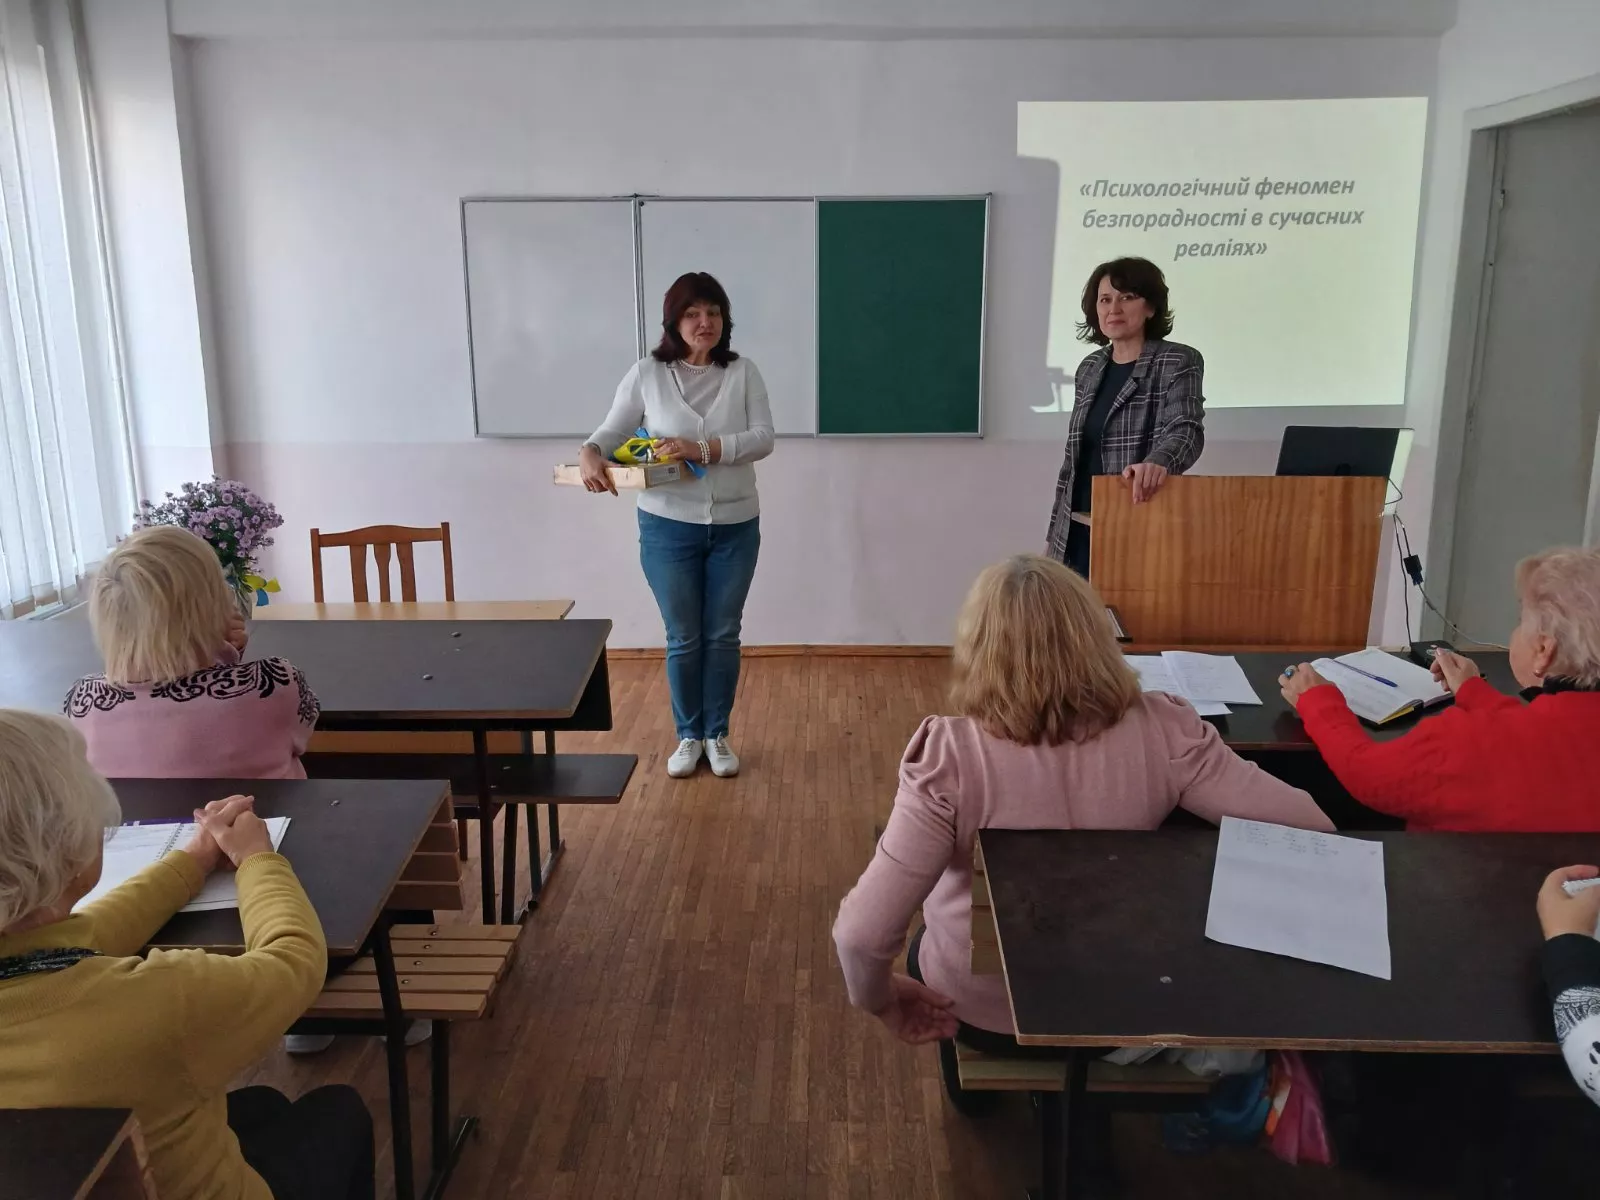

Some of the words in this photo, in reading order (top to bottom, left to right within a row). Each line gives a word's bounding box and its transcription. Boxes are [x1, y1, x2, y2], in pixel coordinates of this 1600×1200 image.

[1079, 177, 1250, 198] «Психологічний
[1254, 177, 1355, 199] феномен
[1082, 208, 1247, 231] безпорадності
[1251, 211, 1263, 226] в
[1268, 209, 1364, 230] сучасних
[1174, 238, 1268, 261] реаліях»
